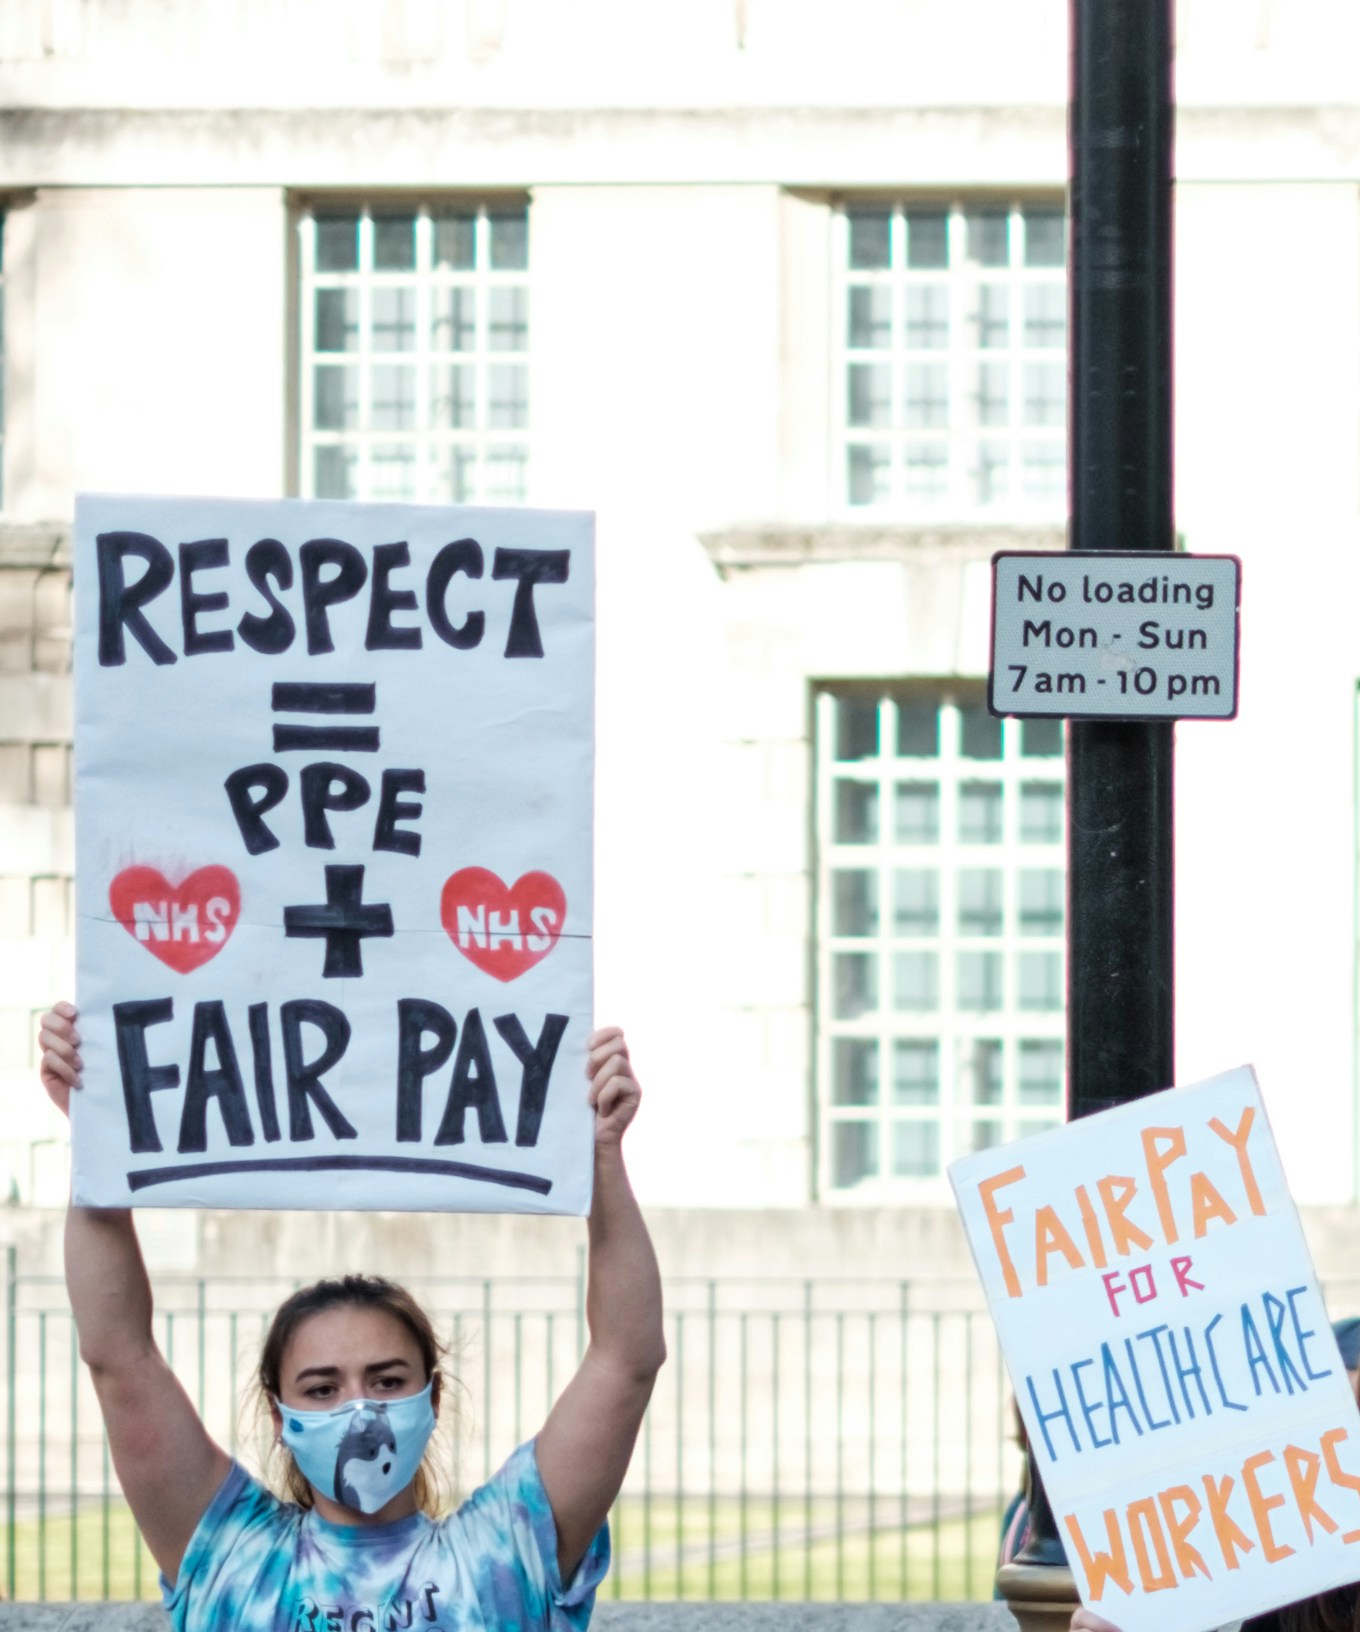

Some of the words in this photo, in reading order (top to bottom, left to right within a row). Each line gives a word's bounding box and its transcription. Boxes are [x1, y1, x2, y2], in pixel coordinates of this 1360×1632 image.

[96, 531, 570, 667] RESPECT
[1017, 574, 1067, 603] No
[1083, 575, 1214, 610] loading
[1022, 620, 1098, 648] Mon
[1137, 620, 1208, 650] Sun
[224, 762, 426, 857] PPE
[132, 896, 230, 944] NHS
[456, 904, 558, 952] NHS
[113, 996, 358, 1154] FAIR
[396, 997, 570, 1148] PAY
[1101, 1256, 1206, 1317] FOR
[1026, 1286, 1333, 1463] HEALTHCARE
